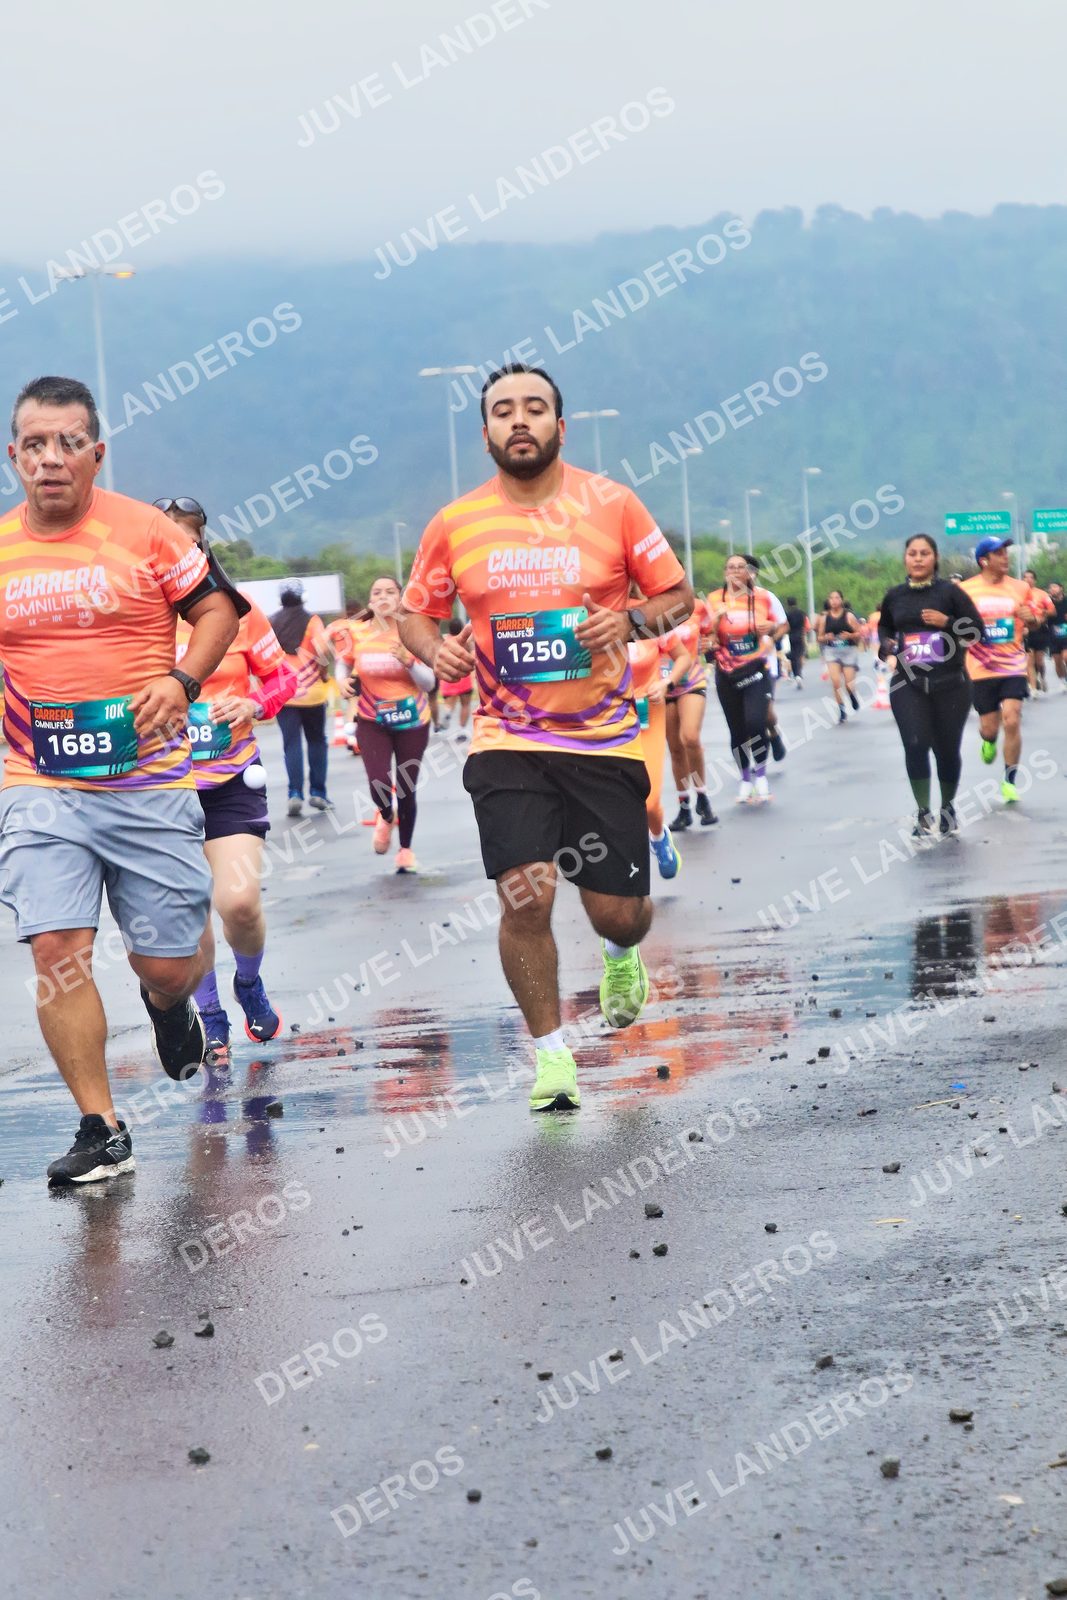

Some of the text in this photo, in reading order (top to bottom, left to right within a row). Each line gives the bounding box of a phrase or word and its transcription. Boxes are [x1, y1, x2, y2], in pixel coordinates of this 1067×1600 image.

[488, 547, 580, 573] CARRERA
[6, 565, 106, 601] CARRERA
[488, 572, 558, 590] OMNILIFE
[6, 594, 84, 619] OMNILIFE
[496, 613, 579, 631] CARRERA 10K
[496, 631, 526, 639] OMNILIFE
[508, 639, 567, 663] 1250
[34, 703, 125, 721] CARRERA 10K
[35, 719, 64, 729] OMNILIFE
[48, 732, 112, 756] 1683
